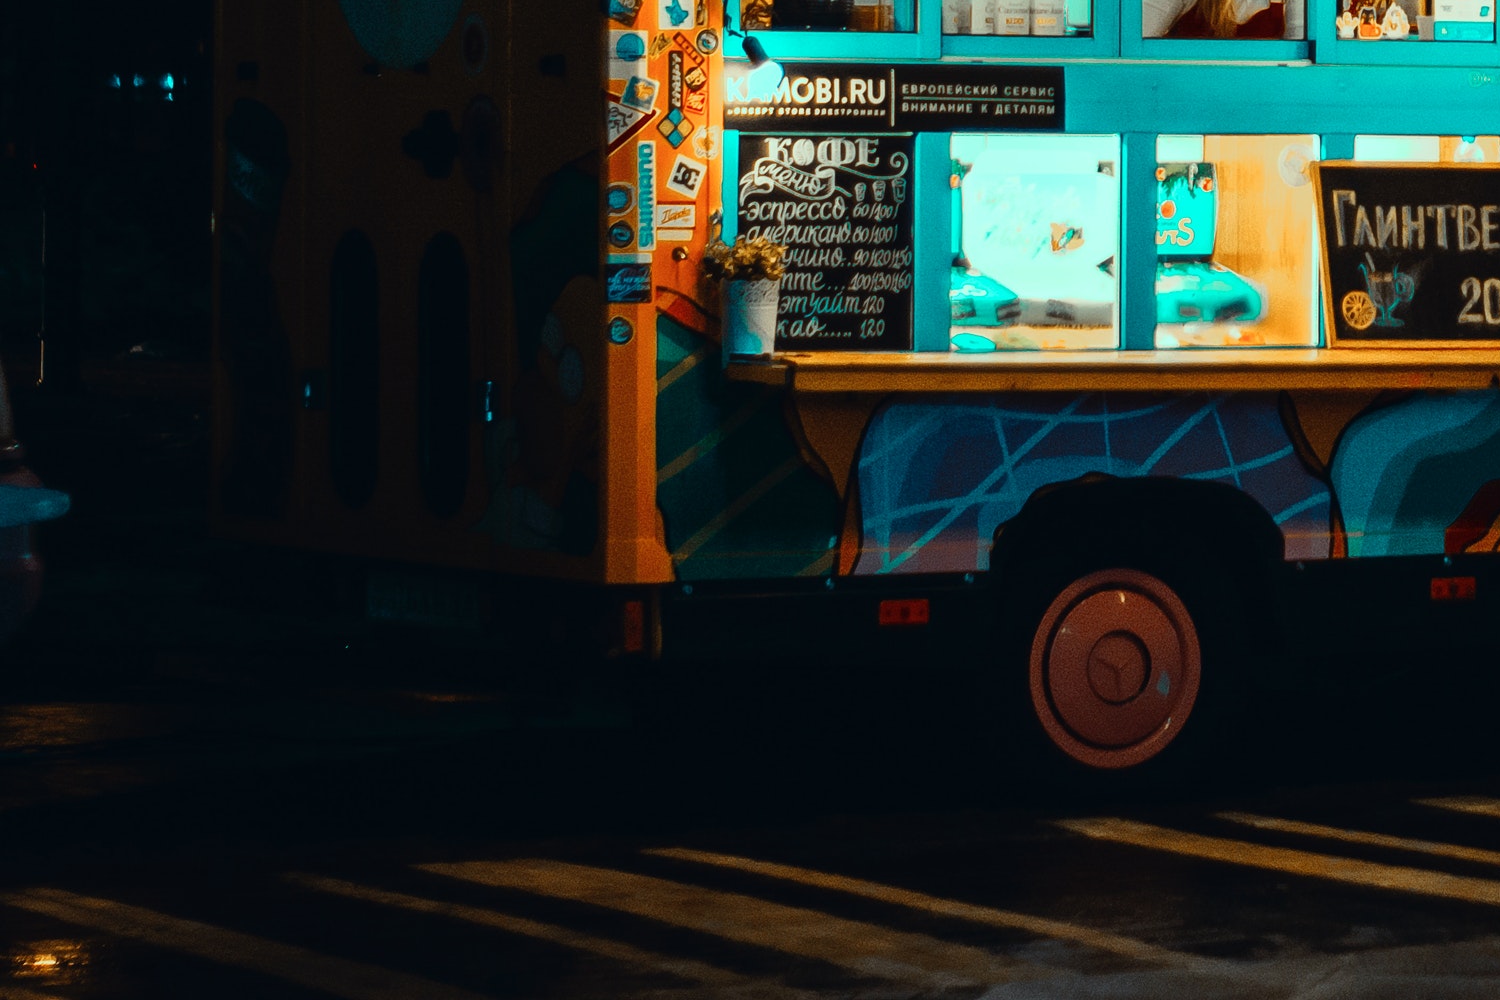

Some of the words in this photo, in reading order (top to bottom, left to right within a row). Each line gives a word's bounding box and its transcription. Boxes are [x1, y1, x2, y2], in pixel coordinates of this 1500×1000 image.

[726, 76, 886, 106] KMOBI.RU
[901, 83, 998, 95] ЕВРОПЕЙСКИЙ
[1003, 85, 1055, 97] СЕРВИС
[901, 102, 973, 113] ВНИМАНИЕ
[981, 103, 988, 113] К
[995, 104, 1056, 115] ДЕТАЛЯМ
[764, 137, 880, 167] КОФЕ
[759, 163, 826, 196] меню
